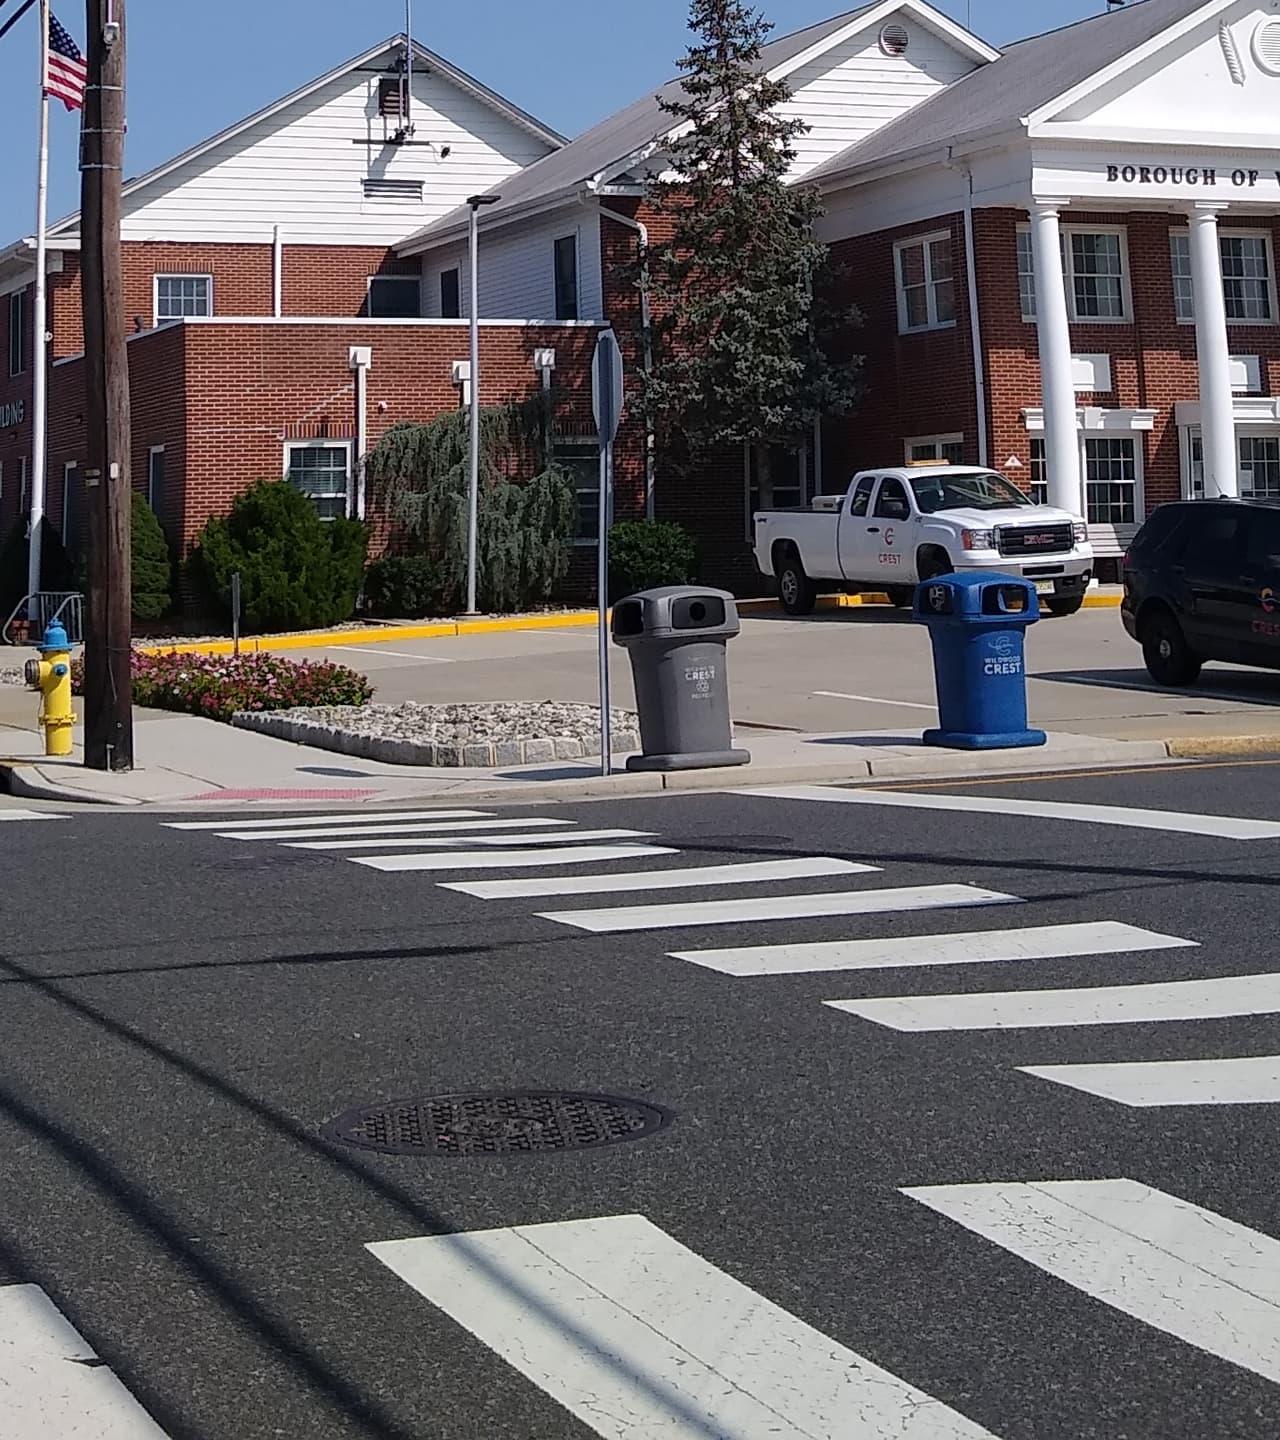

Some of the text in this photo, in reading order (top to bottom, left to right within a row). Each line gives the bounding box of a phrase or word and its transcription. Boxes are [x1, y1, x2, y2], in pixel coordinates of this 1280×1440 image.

[1105, 164, 1218, 186] BOROUGH
[1230, 169, 1260, 187] OF
[1024, 533, 1055, 546] GMC
[879, 553, 901, 565] CREST
[983, 655, 1022, 664] WILDWOOD
[983, 662, 1022, 675] CREST
[684, 669, 716, 681] CREST
